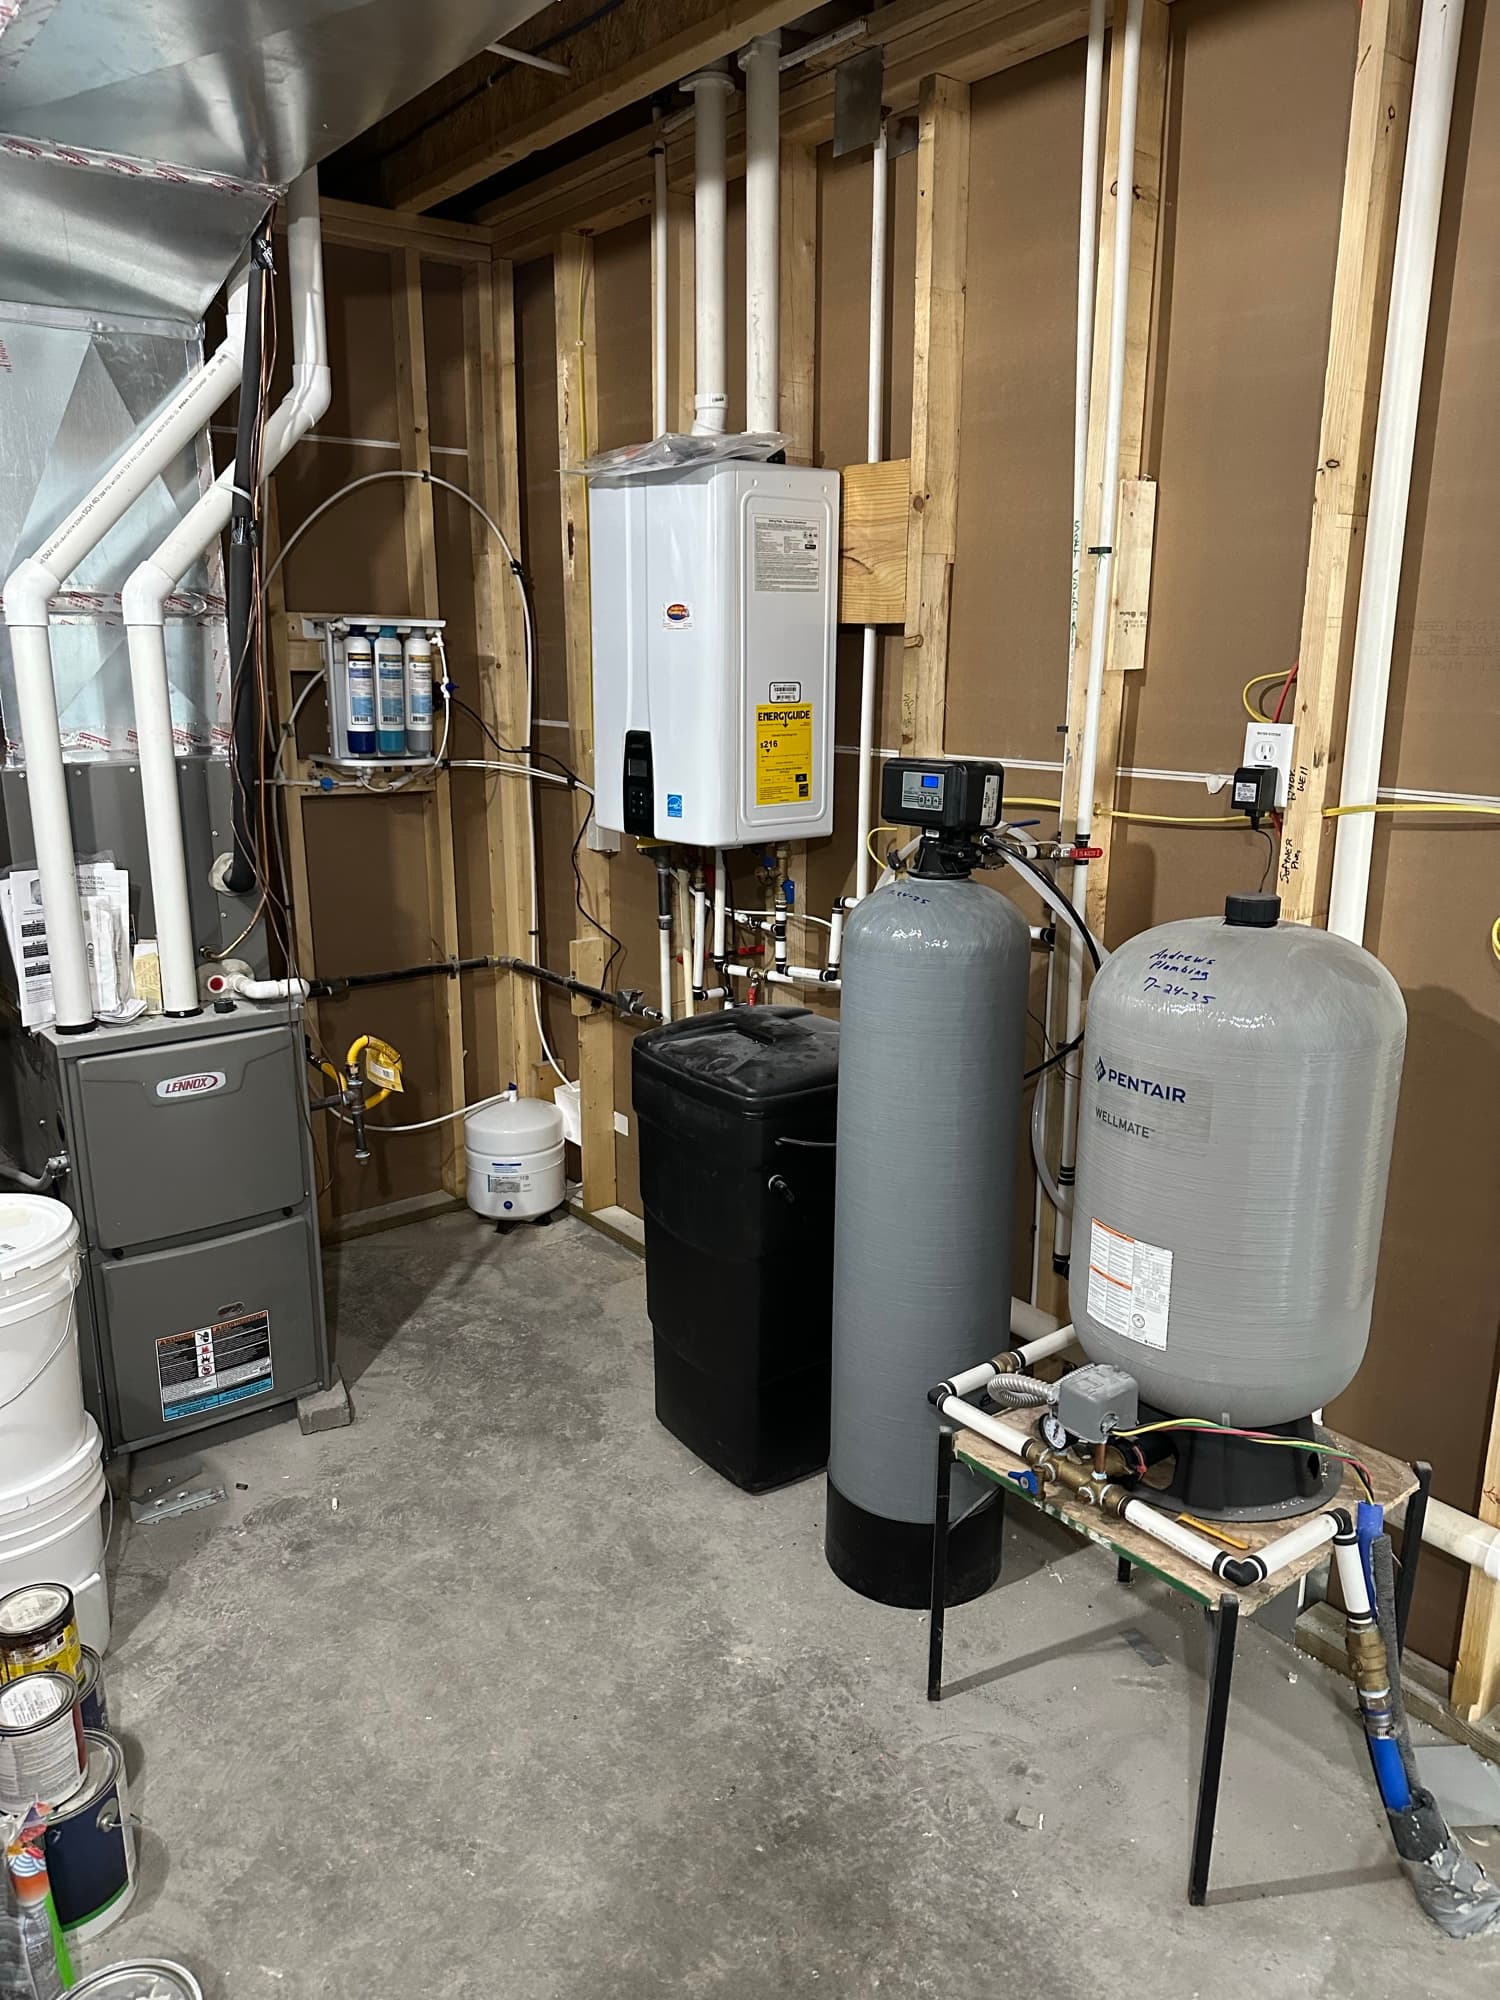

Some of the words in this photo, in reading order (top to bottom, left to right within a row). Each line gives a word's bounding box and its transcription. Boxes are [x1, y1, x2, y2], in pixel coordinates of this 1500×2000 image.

[81, 502, 94, 515] SCH
[758, 711, 810, 723] ENERGYGUIDE
[760, 740, 778, 748] $216
[1144, 977, 1216, 1004] 7-24-25
[165, 1078, 208, 1094] LENNOX
[1108, 1069, 1186, 1103] PENTAIR
